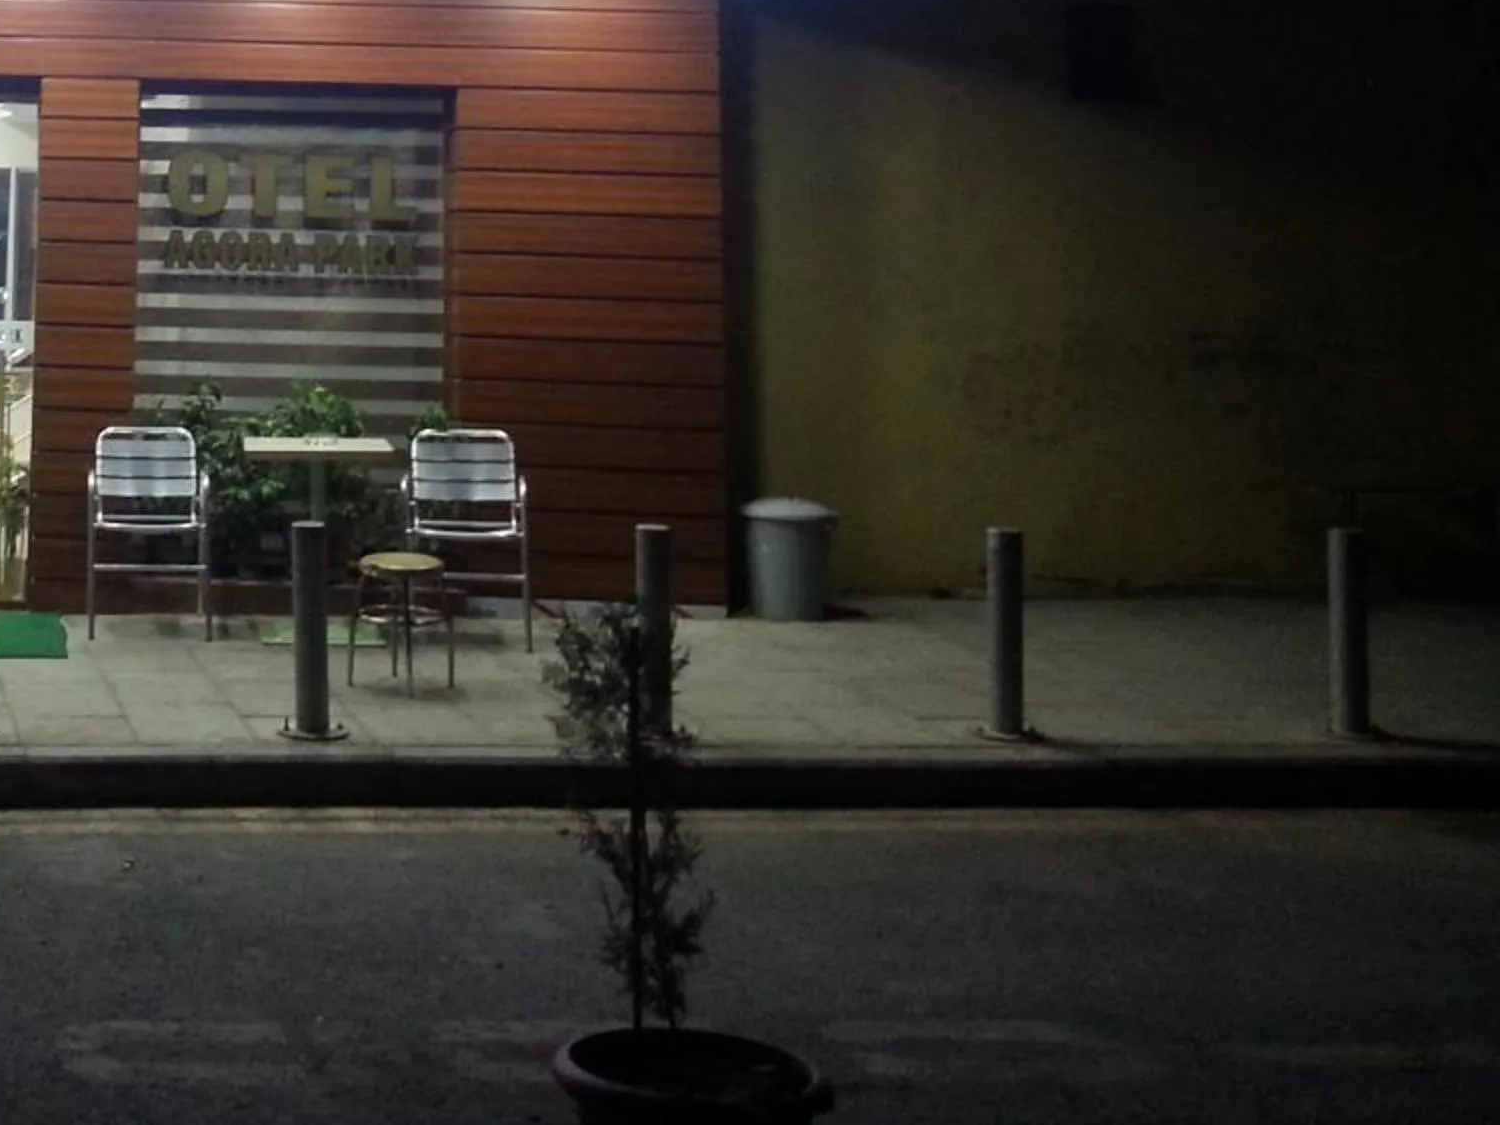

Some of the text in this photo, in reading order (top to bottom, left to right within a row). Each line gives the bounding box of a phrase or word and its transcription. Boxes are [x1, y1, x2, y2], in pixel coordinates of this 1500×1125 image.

[168, 150, 417, 222] OTEL
[163, 229, 419, 275] AGORA PARK
